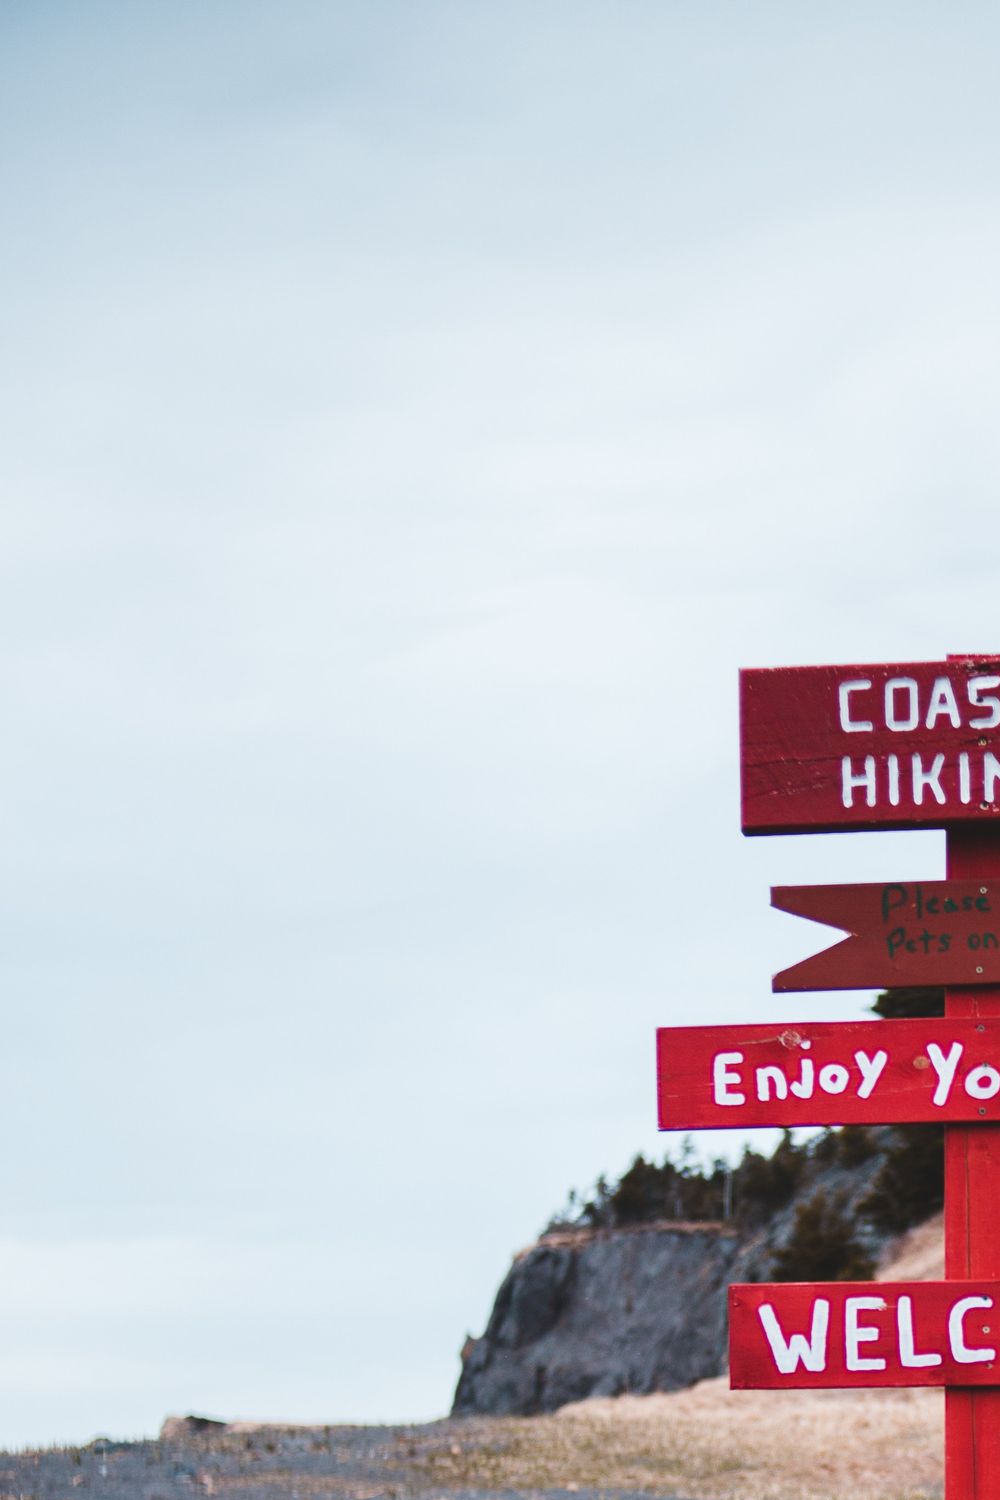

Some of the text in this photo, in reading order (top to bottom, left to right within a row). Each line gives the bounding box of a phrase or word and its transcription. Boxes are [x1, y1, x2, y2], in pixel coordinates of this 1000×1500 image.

[881, 884, 992, 922] Please
[887, 927, 950, 959] Pets
[967, 932, 999, 950] on
[713, 1040, 888, 1106] Enjoy
